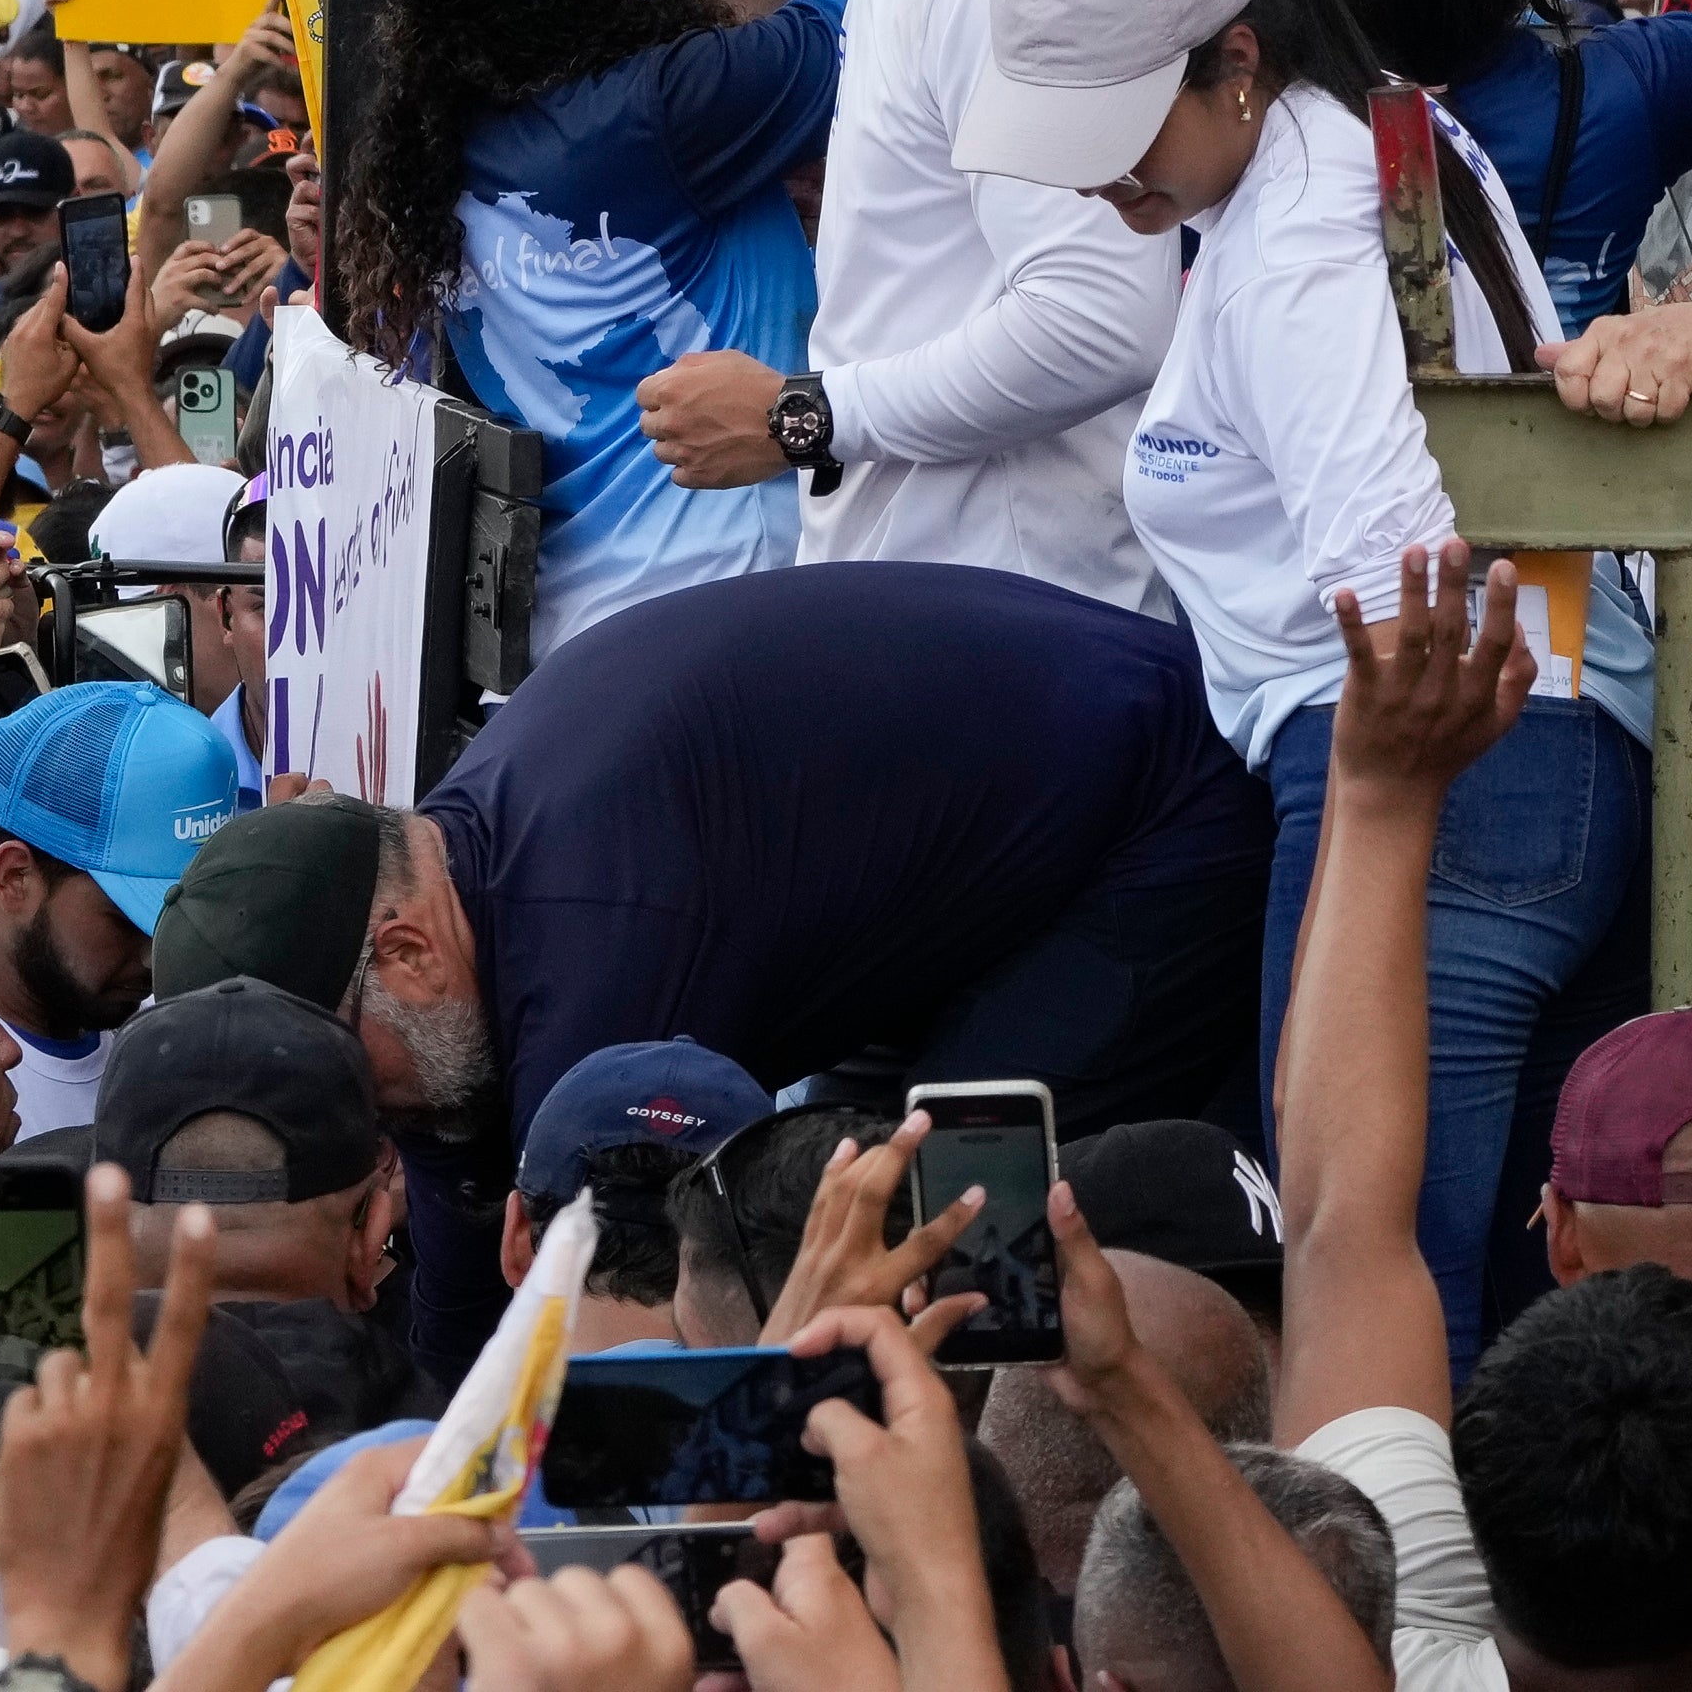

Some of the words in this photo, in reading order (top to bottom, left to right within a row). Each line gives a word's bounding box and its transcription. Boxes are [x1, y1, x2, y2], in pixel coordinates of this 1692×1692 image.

[481, 235, 509, 290] el
[516, 211, 620, 292] final
[1136, 432, 1221, 458] MUNDO
[1138, 465, 1150, 477] DE
[1151, 469, 1186, 483] TODOS
[626, 1106, 707, 1127] ODYSSEY
